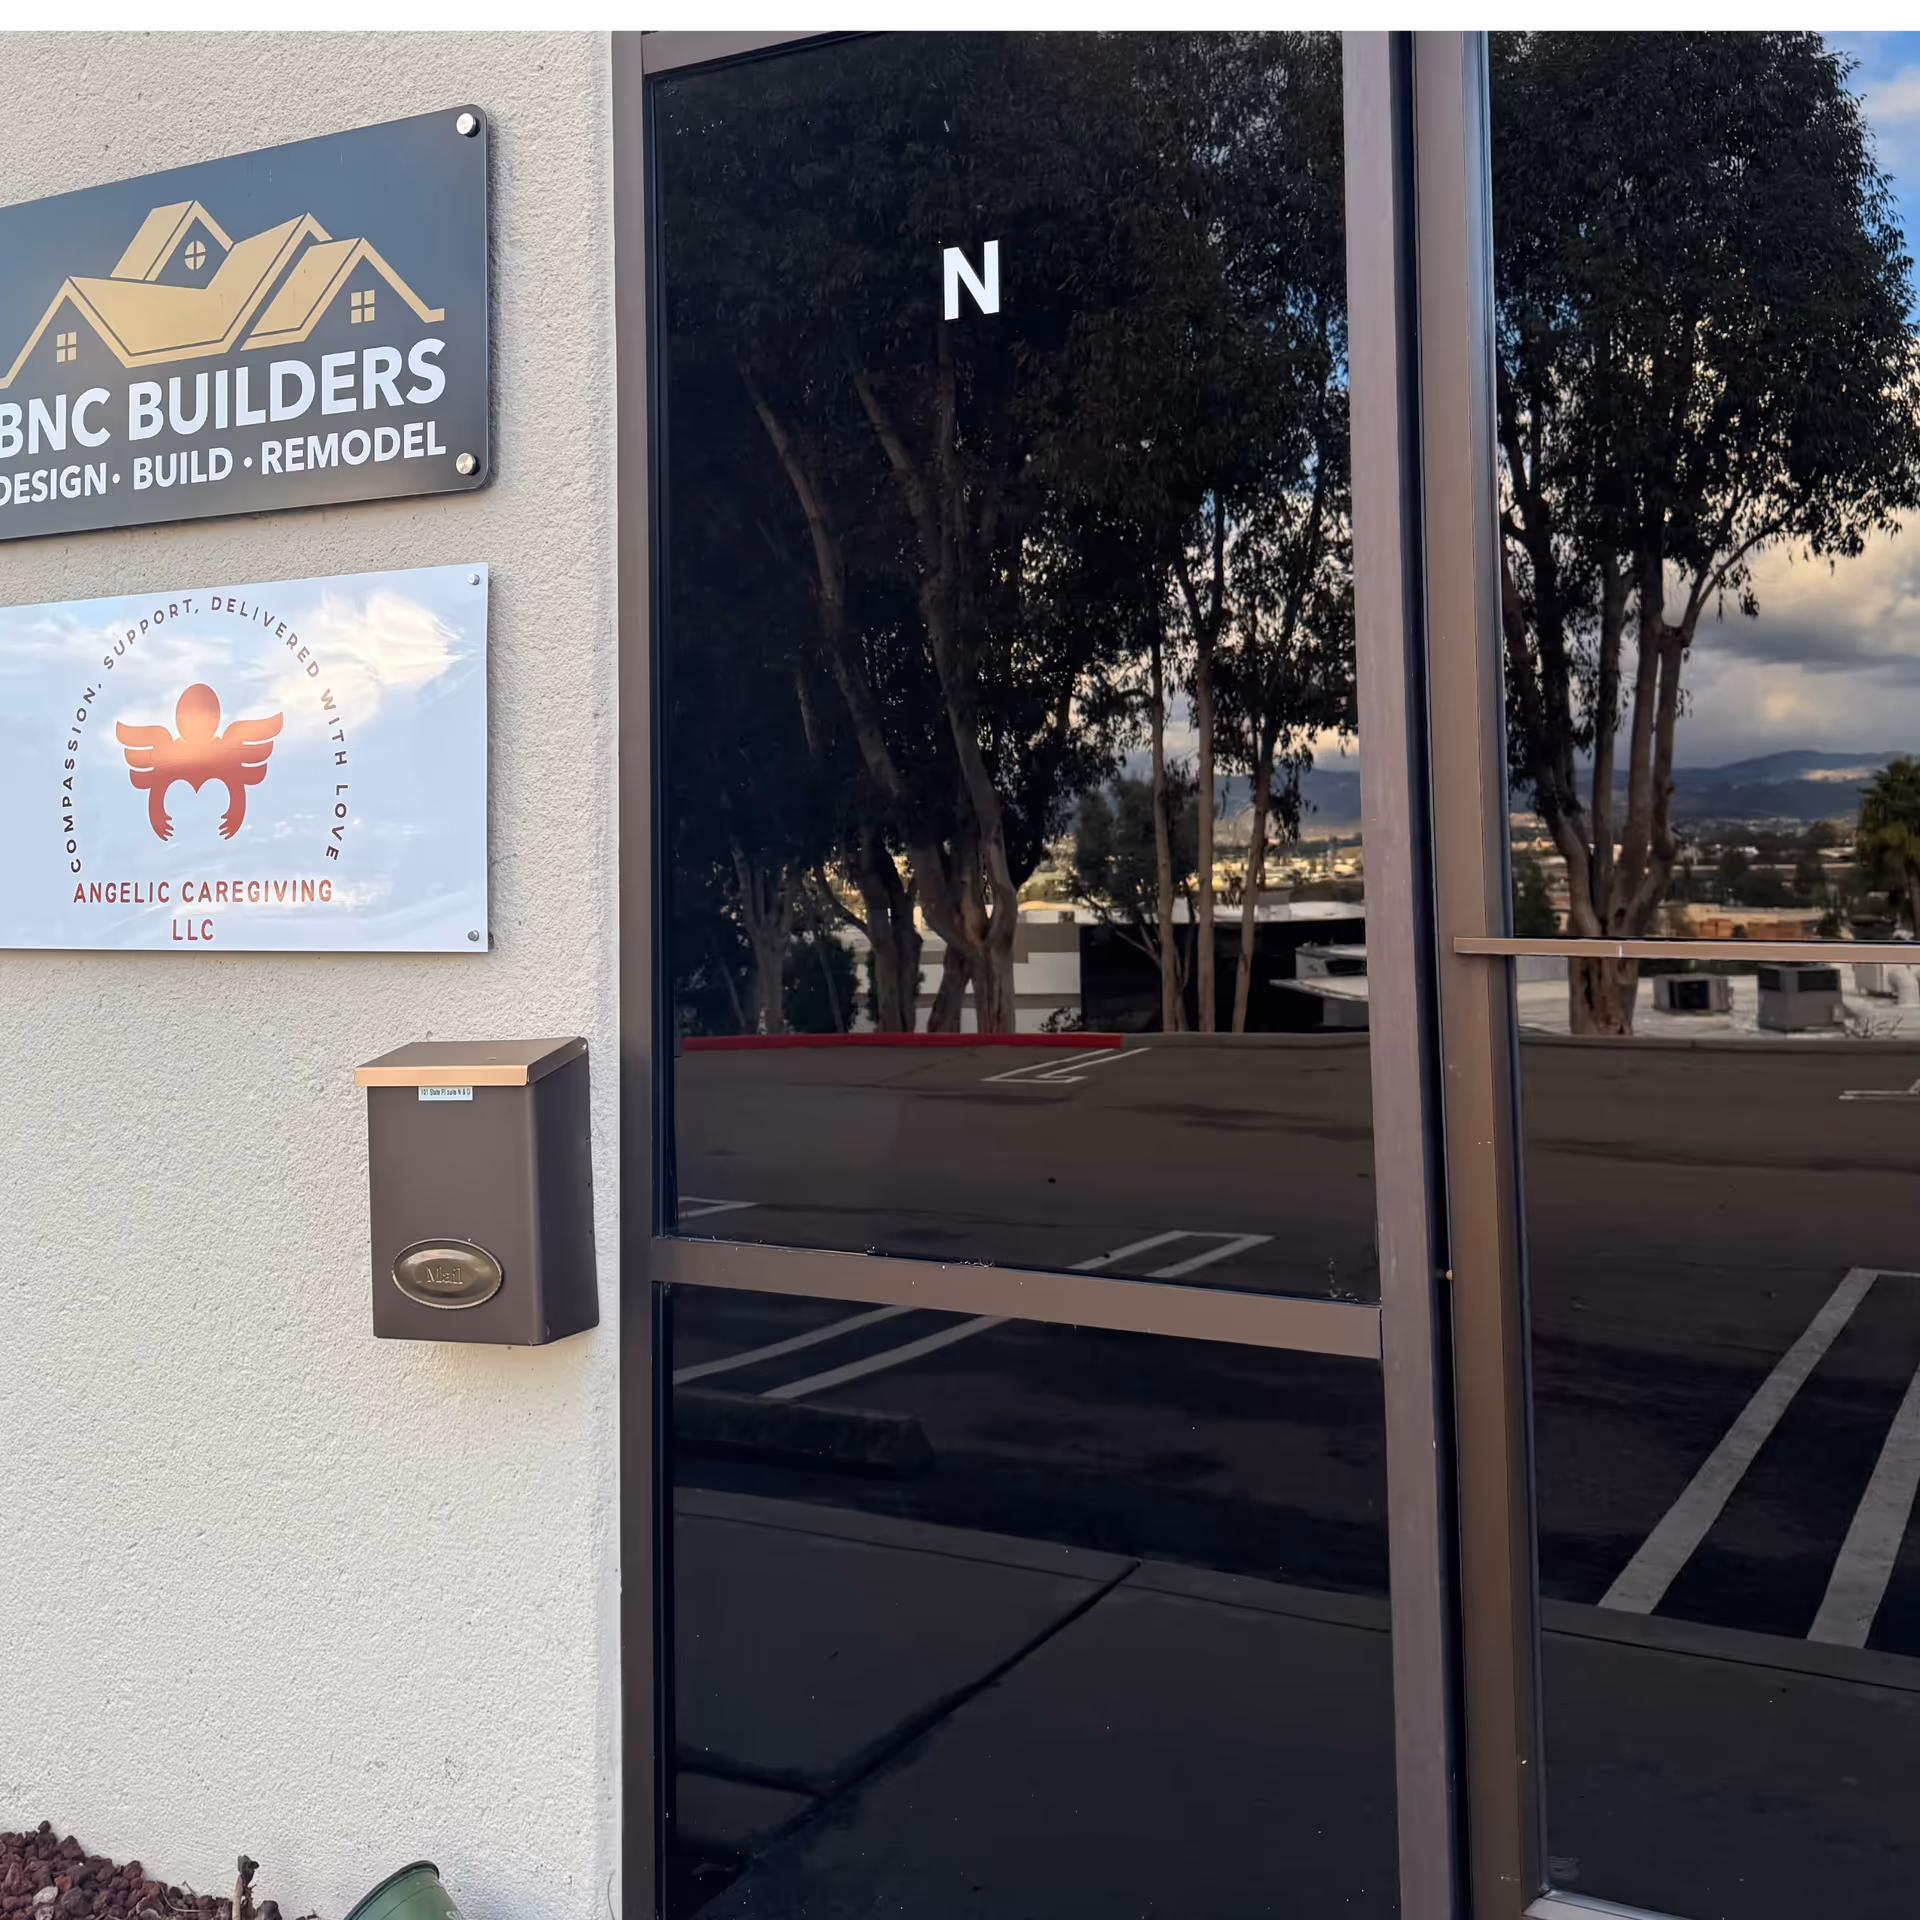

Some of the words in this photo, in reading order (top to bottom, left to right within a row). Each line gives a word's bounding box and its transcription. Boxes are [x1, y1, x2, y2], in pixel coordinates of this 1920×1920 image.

[943, 239, 1000, 321] N
[0, 388, 112, 459] BNC
[128, 338, 446, 441] BUILDERS
[0, 462, 107, 507] DESIGN
[133, 447, 234, 490] BUILD
[261, 421, 447, 475] REMODEL
[103, 598, 199, 670] SUPPORT,
[211, 596, 320, 678] DELIVERED
[320, 687, 348, 766] WITH
[326, 784, 349, 861] LOVE
[73, 881, 170, 903] ANGELIC
[182, 879, 333, 903] CAREGIVING
[172, 919, 214, 941] LLC
[425, 1265, 464, 1285] Mail
